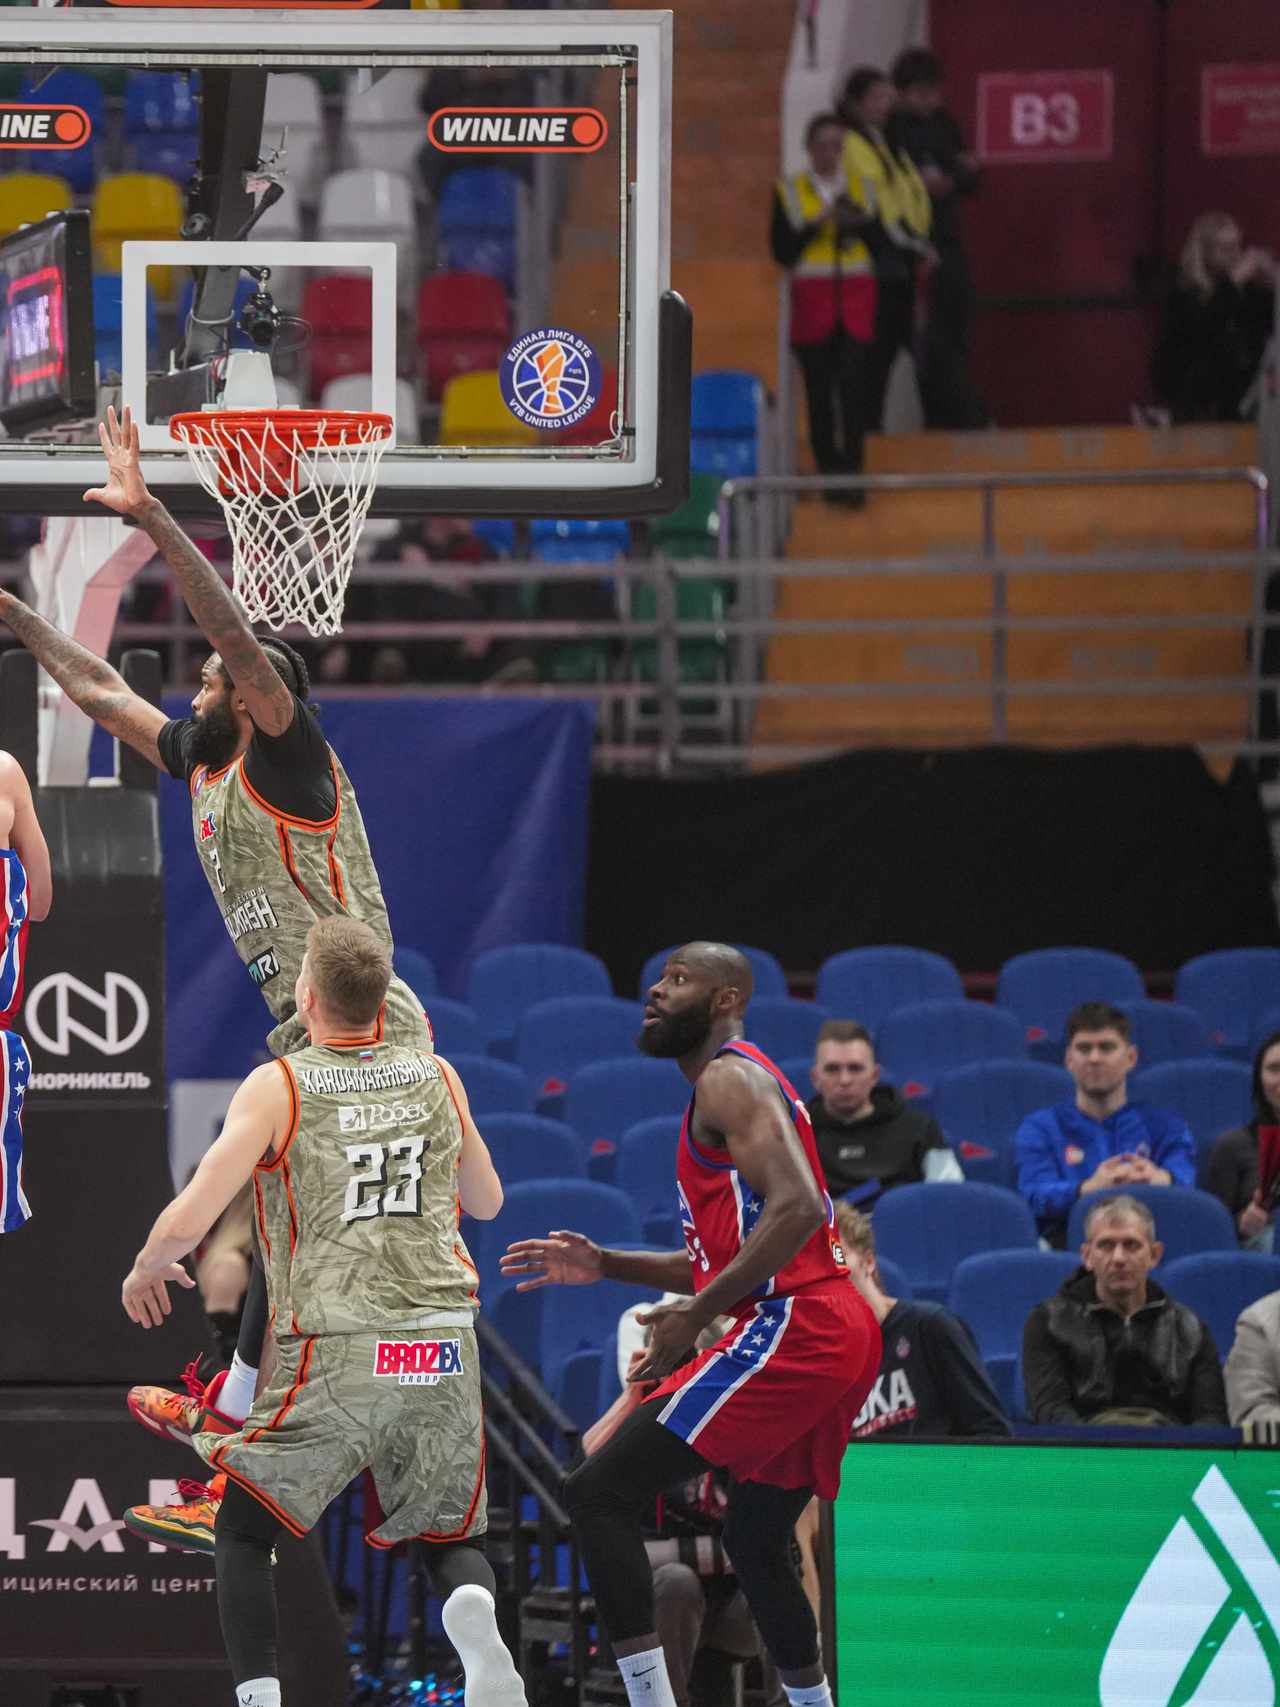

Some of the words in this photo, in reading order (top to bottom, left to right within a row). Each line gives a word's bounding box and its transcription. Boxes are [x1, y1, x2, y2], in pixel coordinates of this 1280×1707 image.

[443, 117, 568, 142] WINLINE
[1011, 92, 1078, 146] B3
[507, 330, 546, 362] ЕДИНАЯ
[547, 329, 575, 344] ЛИГА
[575, 339, 593, 359] ВТБ
[509, 398, 525, 418] VTB
[524, 414, 562, 428] UNITED
[562, 394, 596, 426] LEAGUE
[224, 894, 279, 942] LMASH
[28, 1072, 152, 1090] НОРНИКЕЛЬ
[367, 1099, 431, 1124] Робек
[340, 1135, 431, 1226] 23
[376, 1340, 462, 1375] BROZEX
[400, 1375, 439, 1383] GROUP
[151, 1577, 217, 1594] цент
